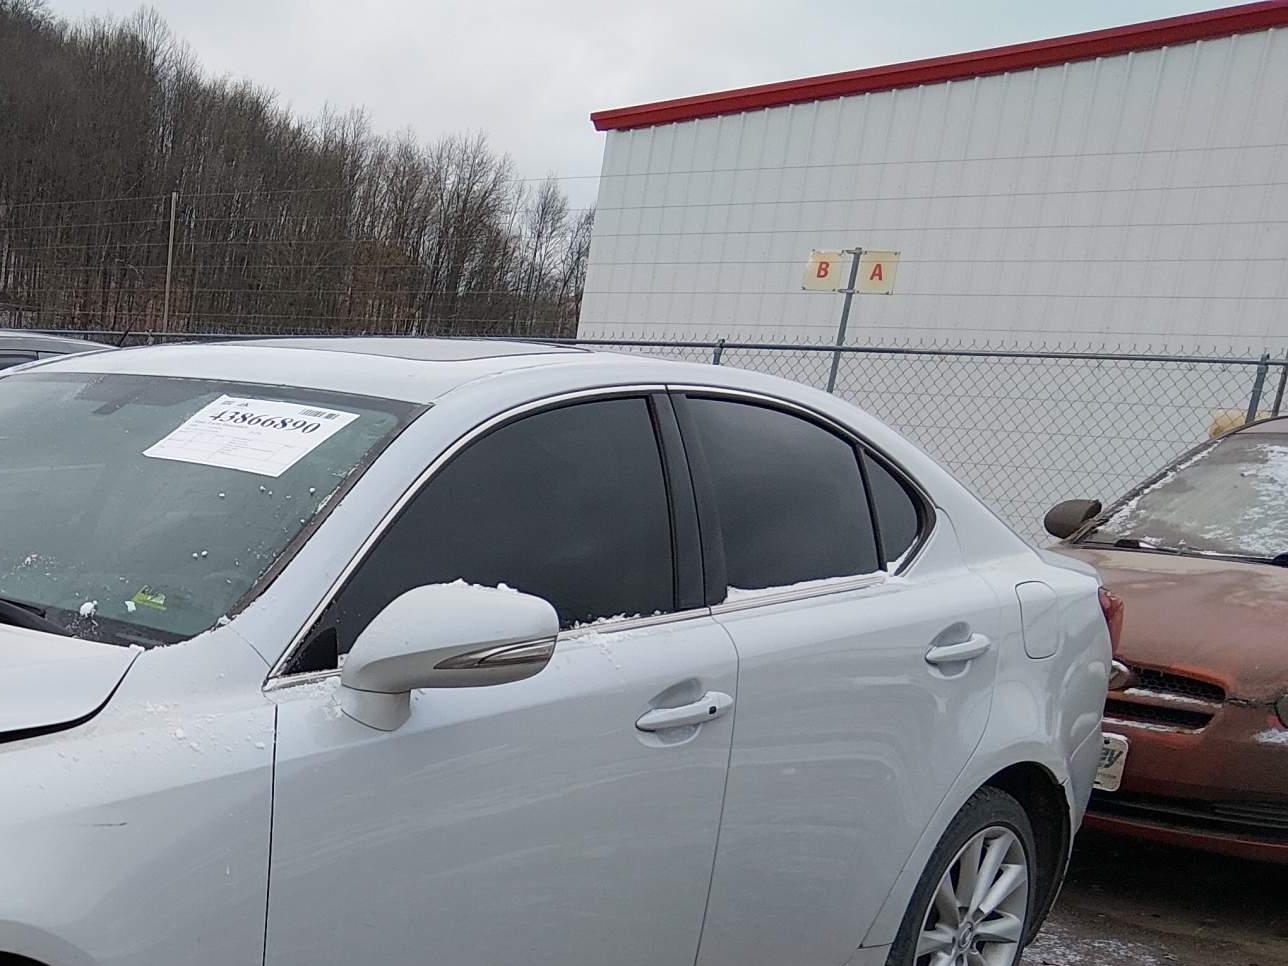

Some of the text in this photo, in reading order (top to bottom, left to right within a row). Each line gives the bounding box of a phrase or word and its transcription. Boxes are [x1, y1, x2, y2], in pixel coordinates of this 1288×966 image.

[816, 261, 830, 279] B
[869, 263, 883, 281] A
[209, 409, 321, 435] 43866890
